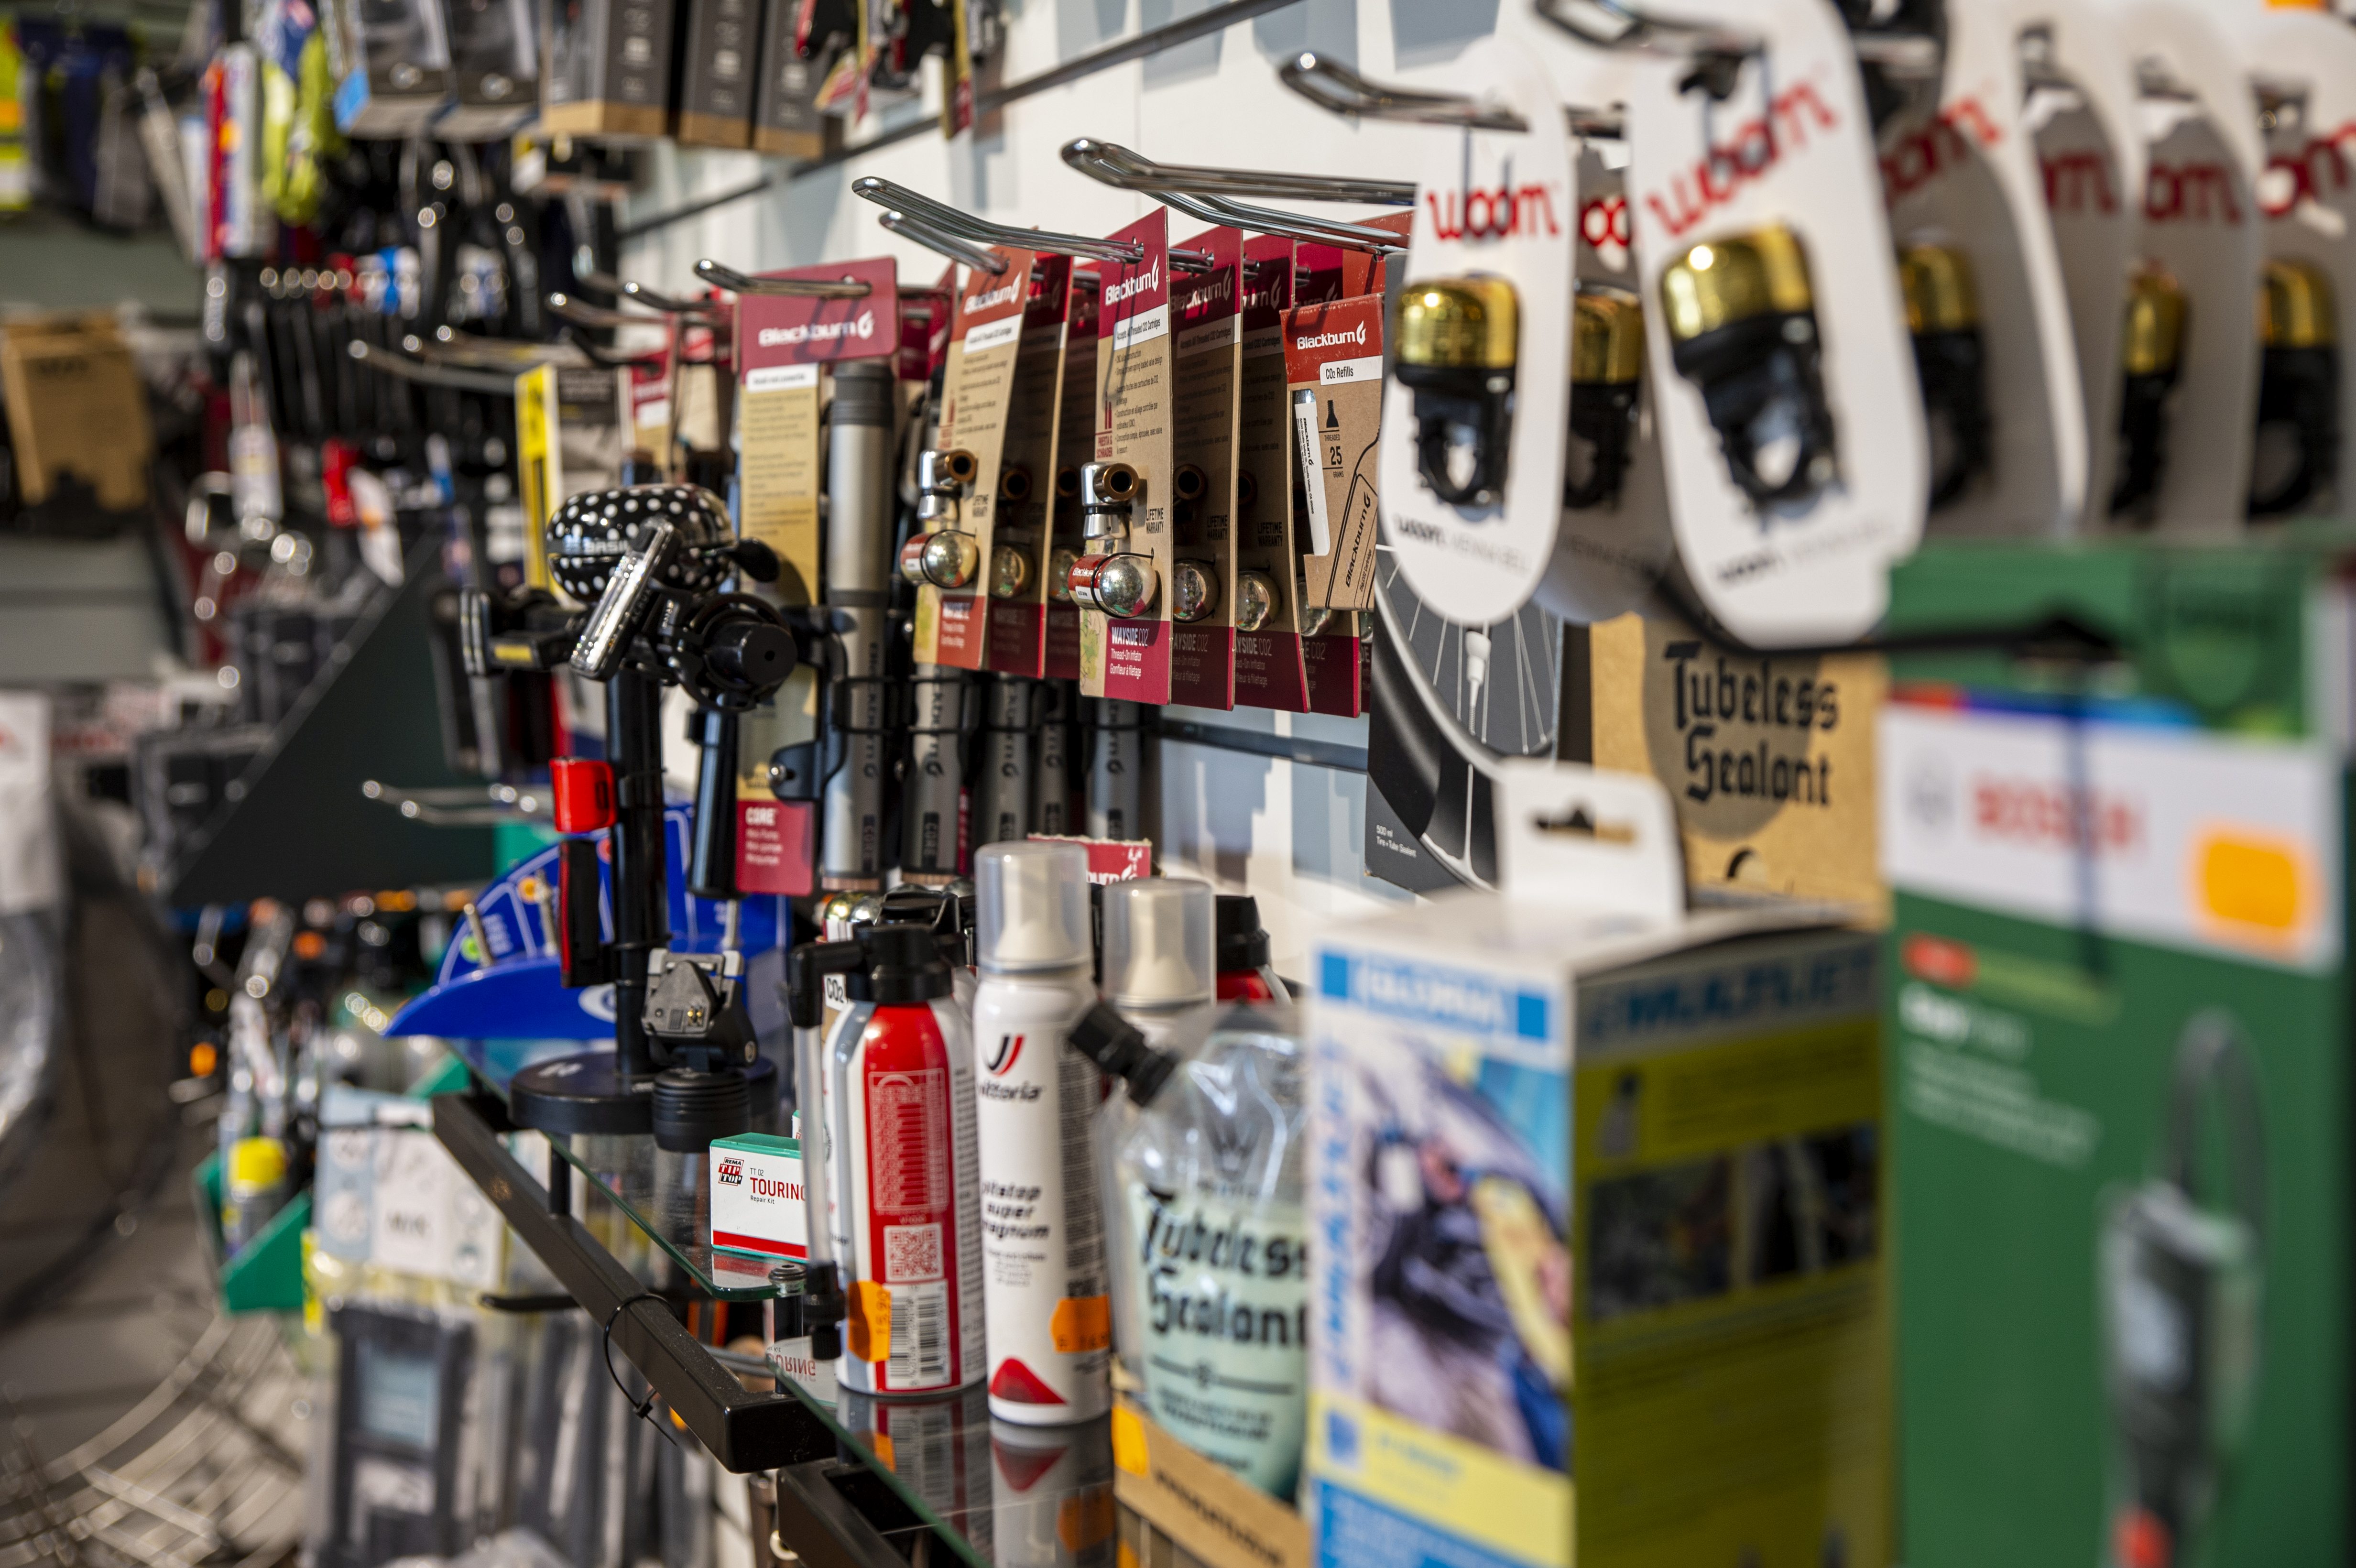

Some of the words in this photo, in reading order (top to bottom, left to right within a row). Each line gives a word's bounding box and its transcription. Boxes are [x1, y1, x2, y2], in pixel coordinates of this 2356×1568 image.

[1428, 183, 1560, 243] woom
[1105, 272, 1151, 306] Blackburn
[1148, 318, 1160, 330] Cartridges
[1297, 331, 1355, 350] Blackburn
[1337, 366, 1353, 379] Refills
[1303, 417, 1311, 459] Blackburn
[1330, 446, 1342, 466] 25
[1146, 507, 1164, 521] LIFETIME
[1207, 514, 1227, 528] LIFETIME
[1146, 521, 1164, 534] WARRANTY
[1258, 522, 1283, 534] LIFETIME
[1258, 534, 1283, 547] WARRANTY
[1346, 508, 1367, 588] Blackburn
[1112, 627, 1138, 646] WAYSIDE
[1172, 633, 1196, 651] AYSIDE
[1236, 636, 1258, 654] YSIDE
[1111, 648, 1130, 660] Thread-On
[1664, 639, 1841, 730] Tubeless
[1685, 726, 1831, 806] Sealant
[720, 1164, 740, 1175] TIP
[722, 1174, 742, 1184] TOP
